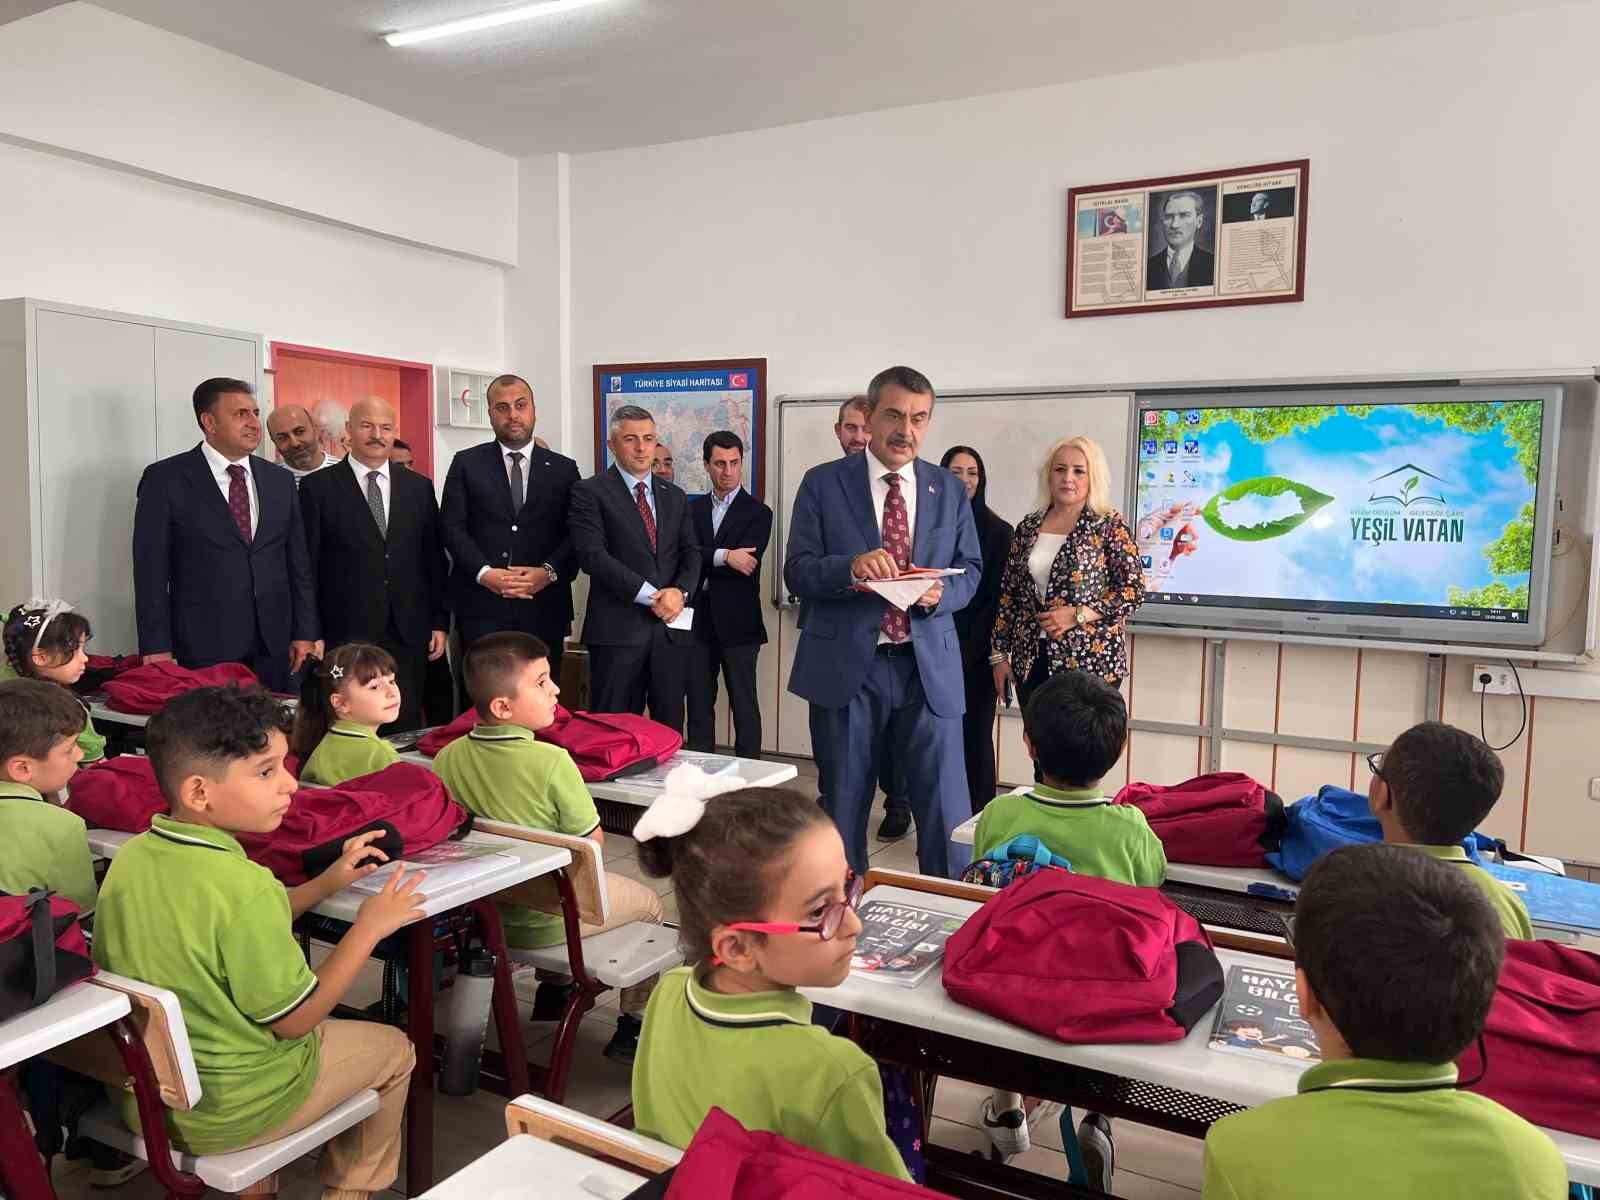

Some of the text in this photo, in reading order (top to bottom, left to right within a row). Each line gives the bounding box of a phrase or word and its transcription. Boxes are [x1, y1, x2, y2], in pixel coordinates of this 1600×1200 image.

[634, 377, 723, 388] TÜRKİYE SİYASİ HARİTASI
[1403, 518, 1464, 543] VATAN
[1241, 974, 1297, 991] HAY
[1248, 985, 1300, 1004] BİLG
